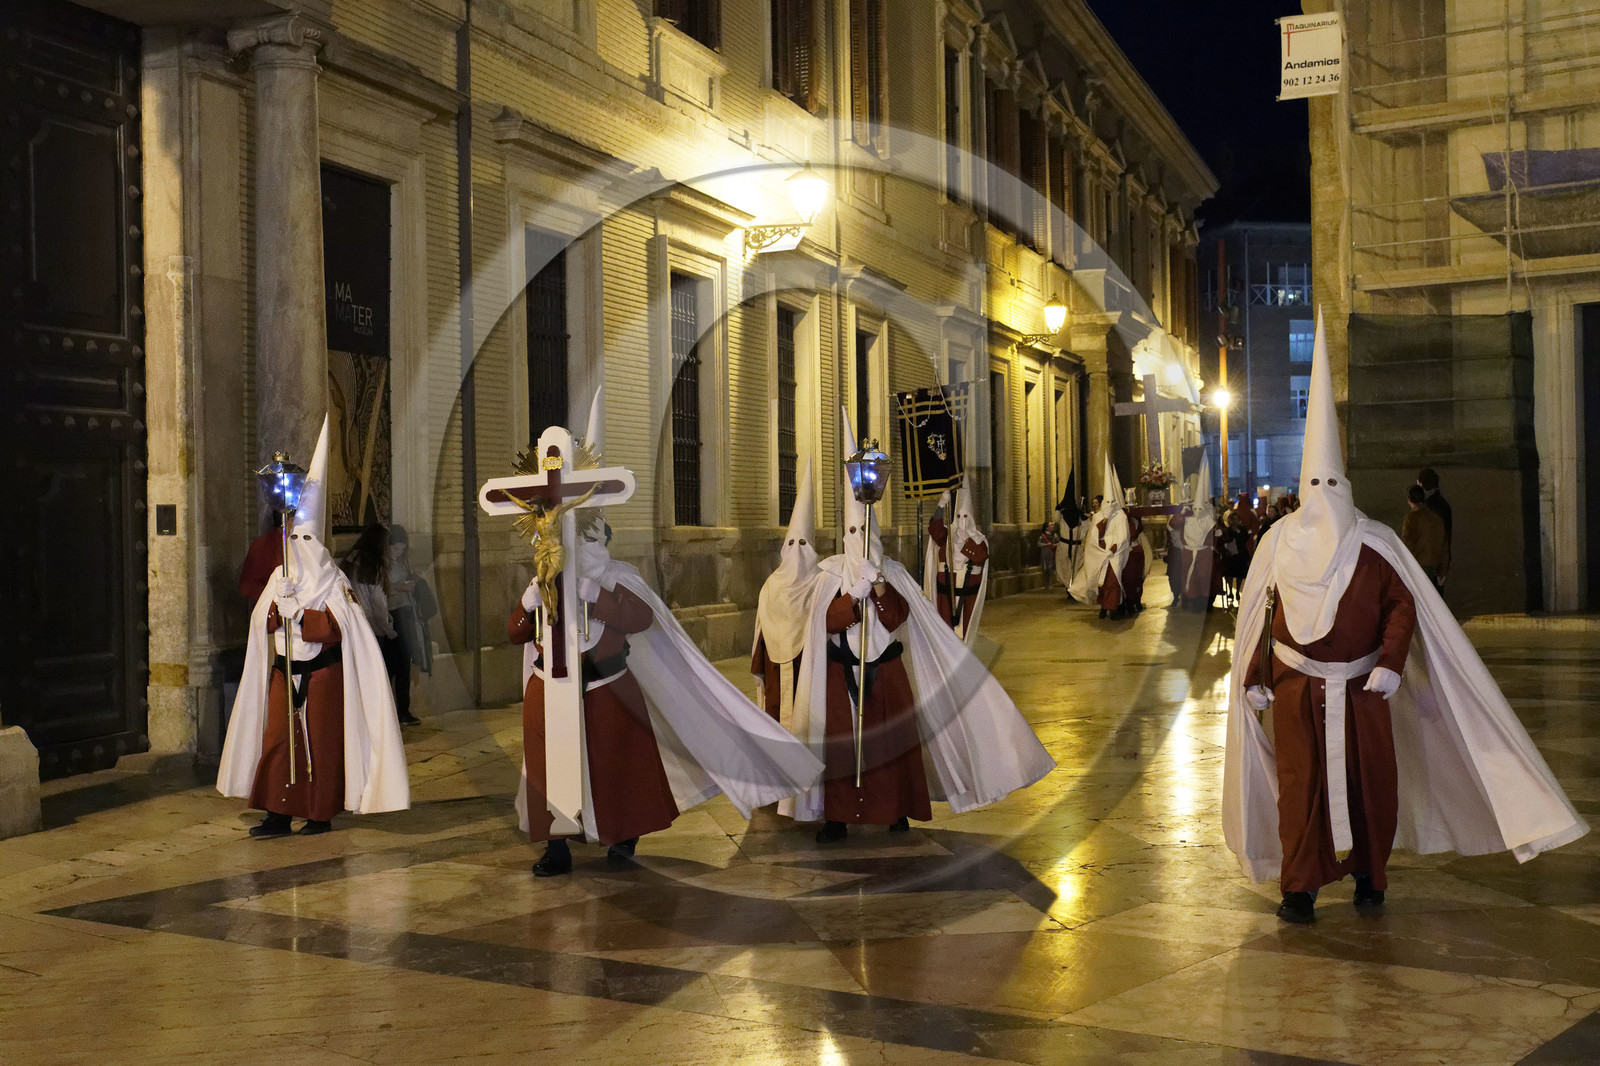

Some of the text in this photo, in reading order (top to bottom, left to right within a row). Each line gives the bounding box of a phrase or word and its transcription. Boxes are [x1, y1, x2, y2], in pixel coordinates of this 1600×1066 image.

[1284, 58, 1340, 70] Andamios
[1283, 73, 1340, 87] 902 12 24 36
